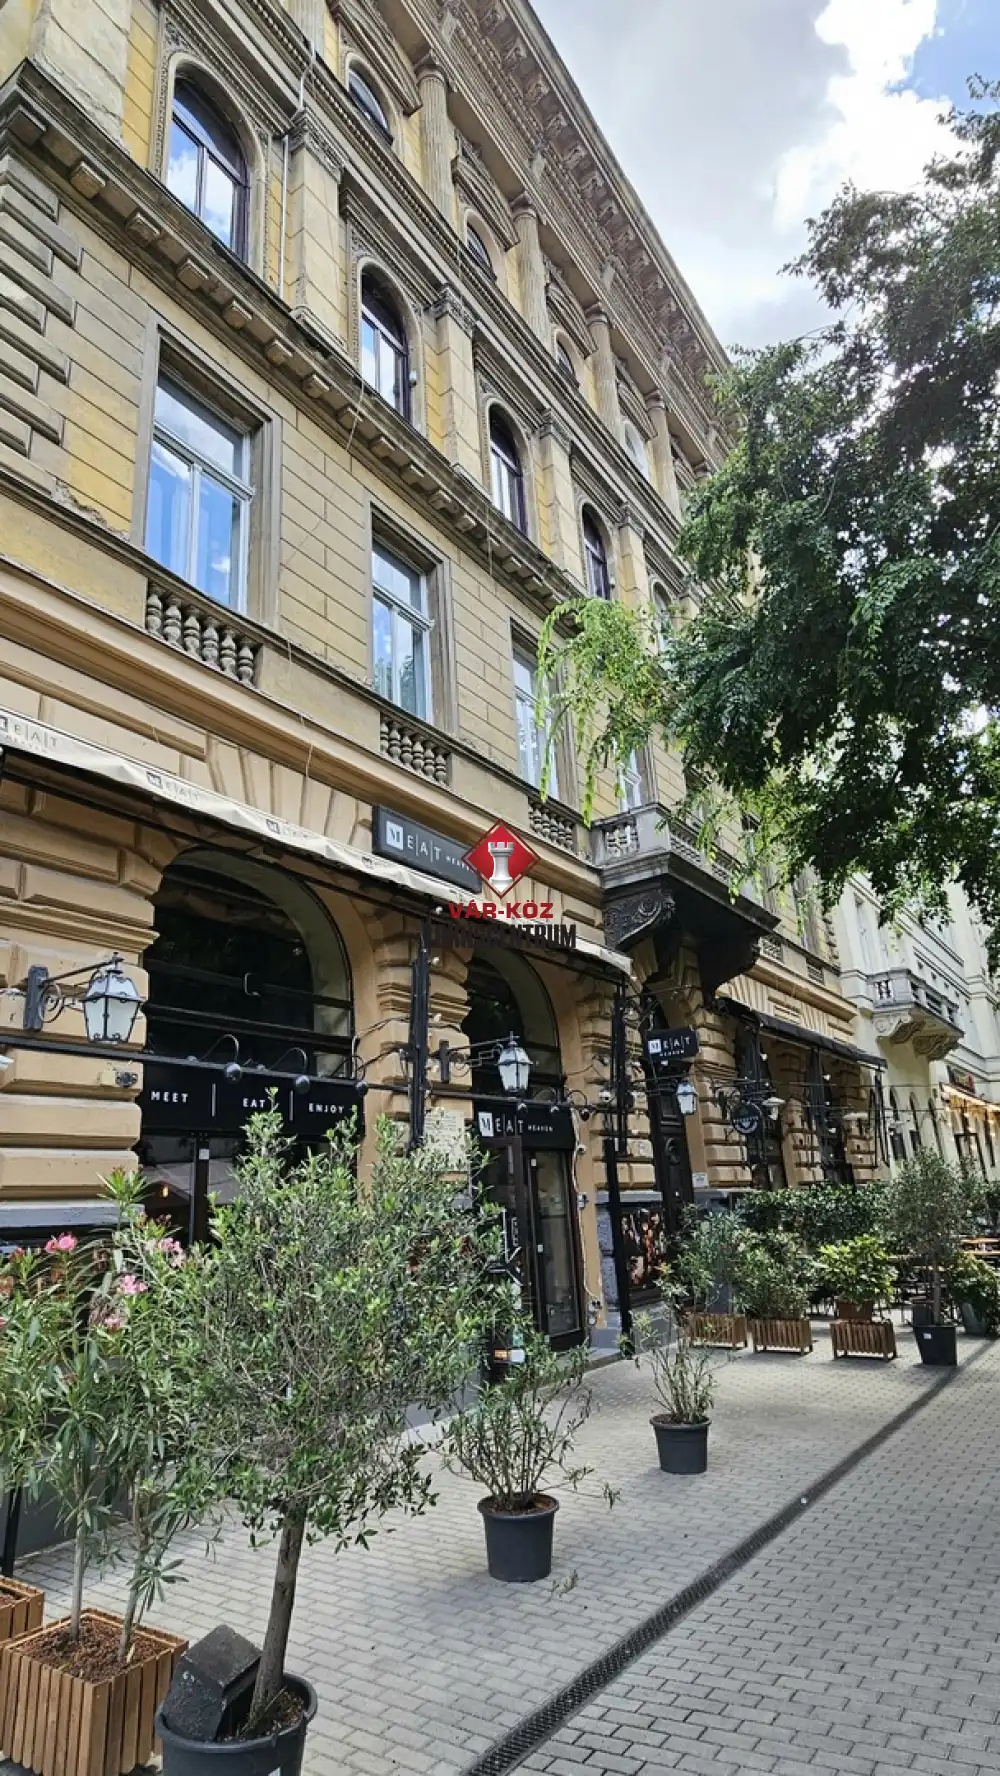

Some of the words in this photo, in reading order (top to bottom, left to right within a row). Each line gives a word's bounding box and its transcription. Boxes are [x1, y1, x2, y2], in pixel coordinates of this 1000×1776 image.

[151, 1091, 189, 1103] MEET
[242, 1098, 266, 1108] EAT
[308, 1103, 345, 1114] ENJOY
